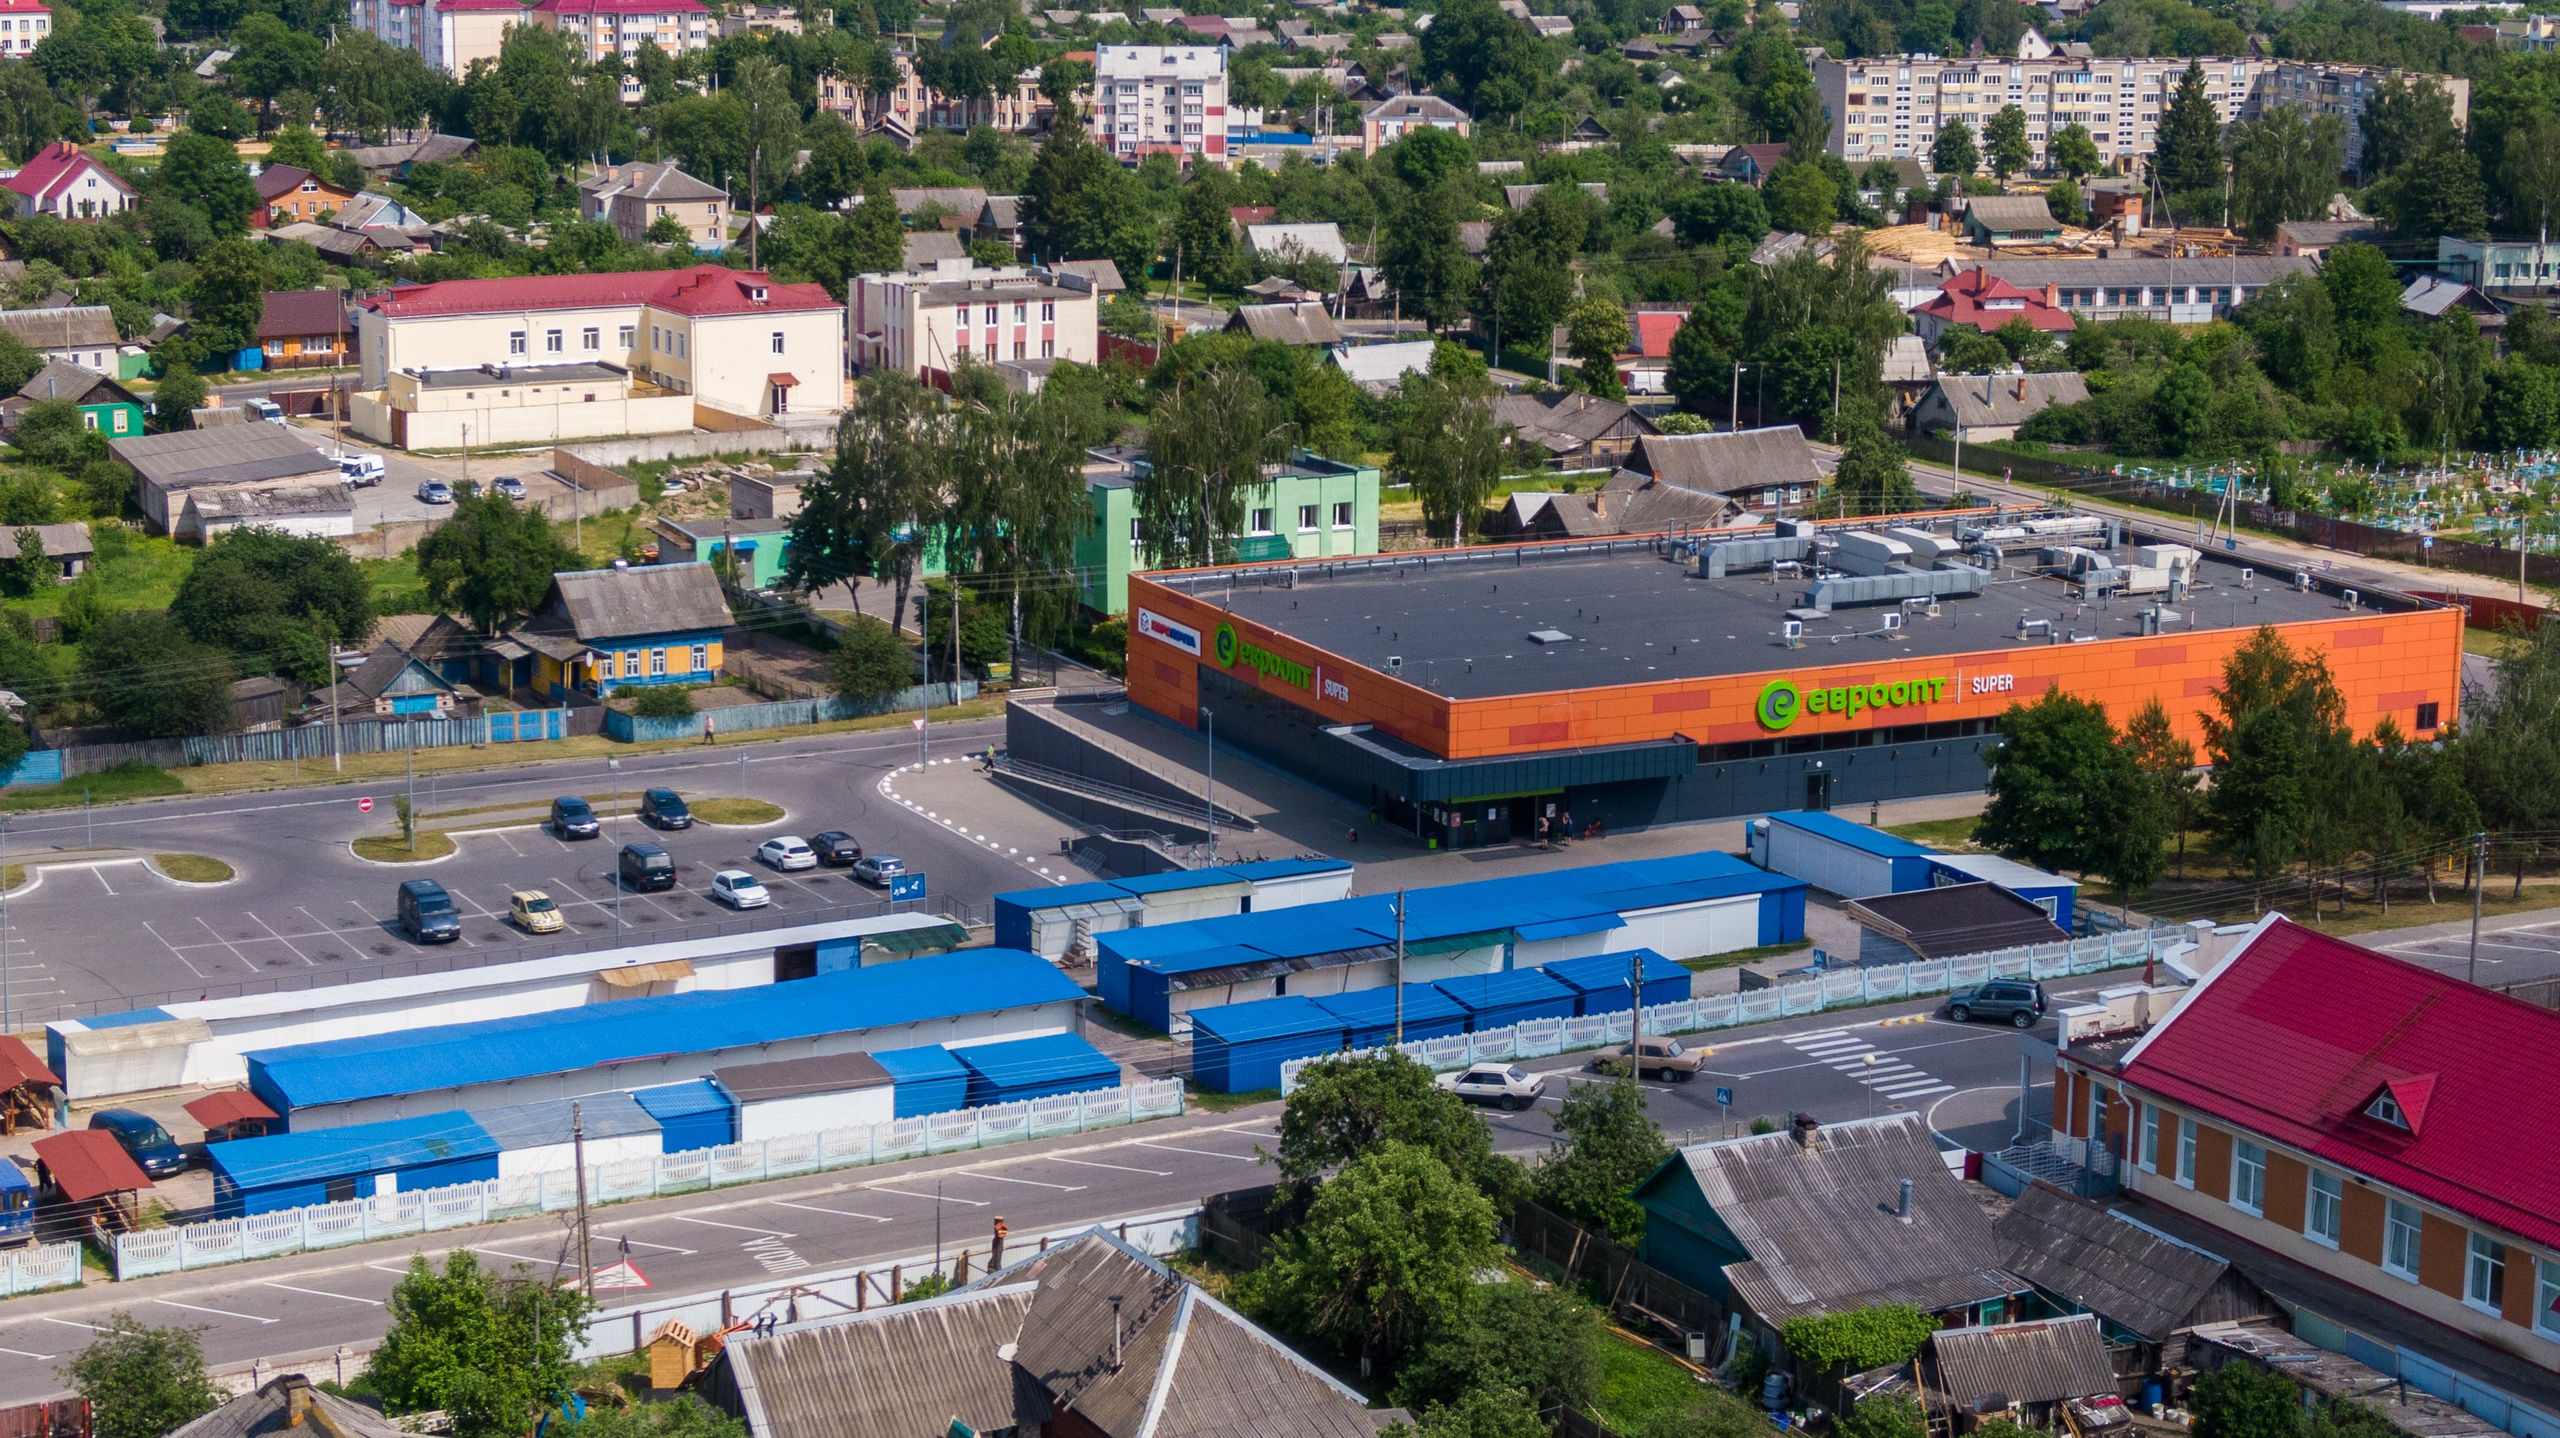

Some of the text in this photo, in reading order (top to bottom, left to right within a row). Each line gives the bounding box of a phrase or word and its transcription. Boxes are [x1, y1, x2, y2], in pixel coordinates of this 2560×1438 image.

[1240, 641, 1312, 690] евроопт
[1972, 674, 2014, 694] SUPER
[1324, 678, 1349, 702] SUPER
[1808, 677, 1948, 718] евроопт
[740, 1236, 810, 1273] ШКОЛА
